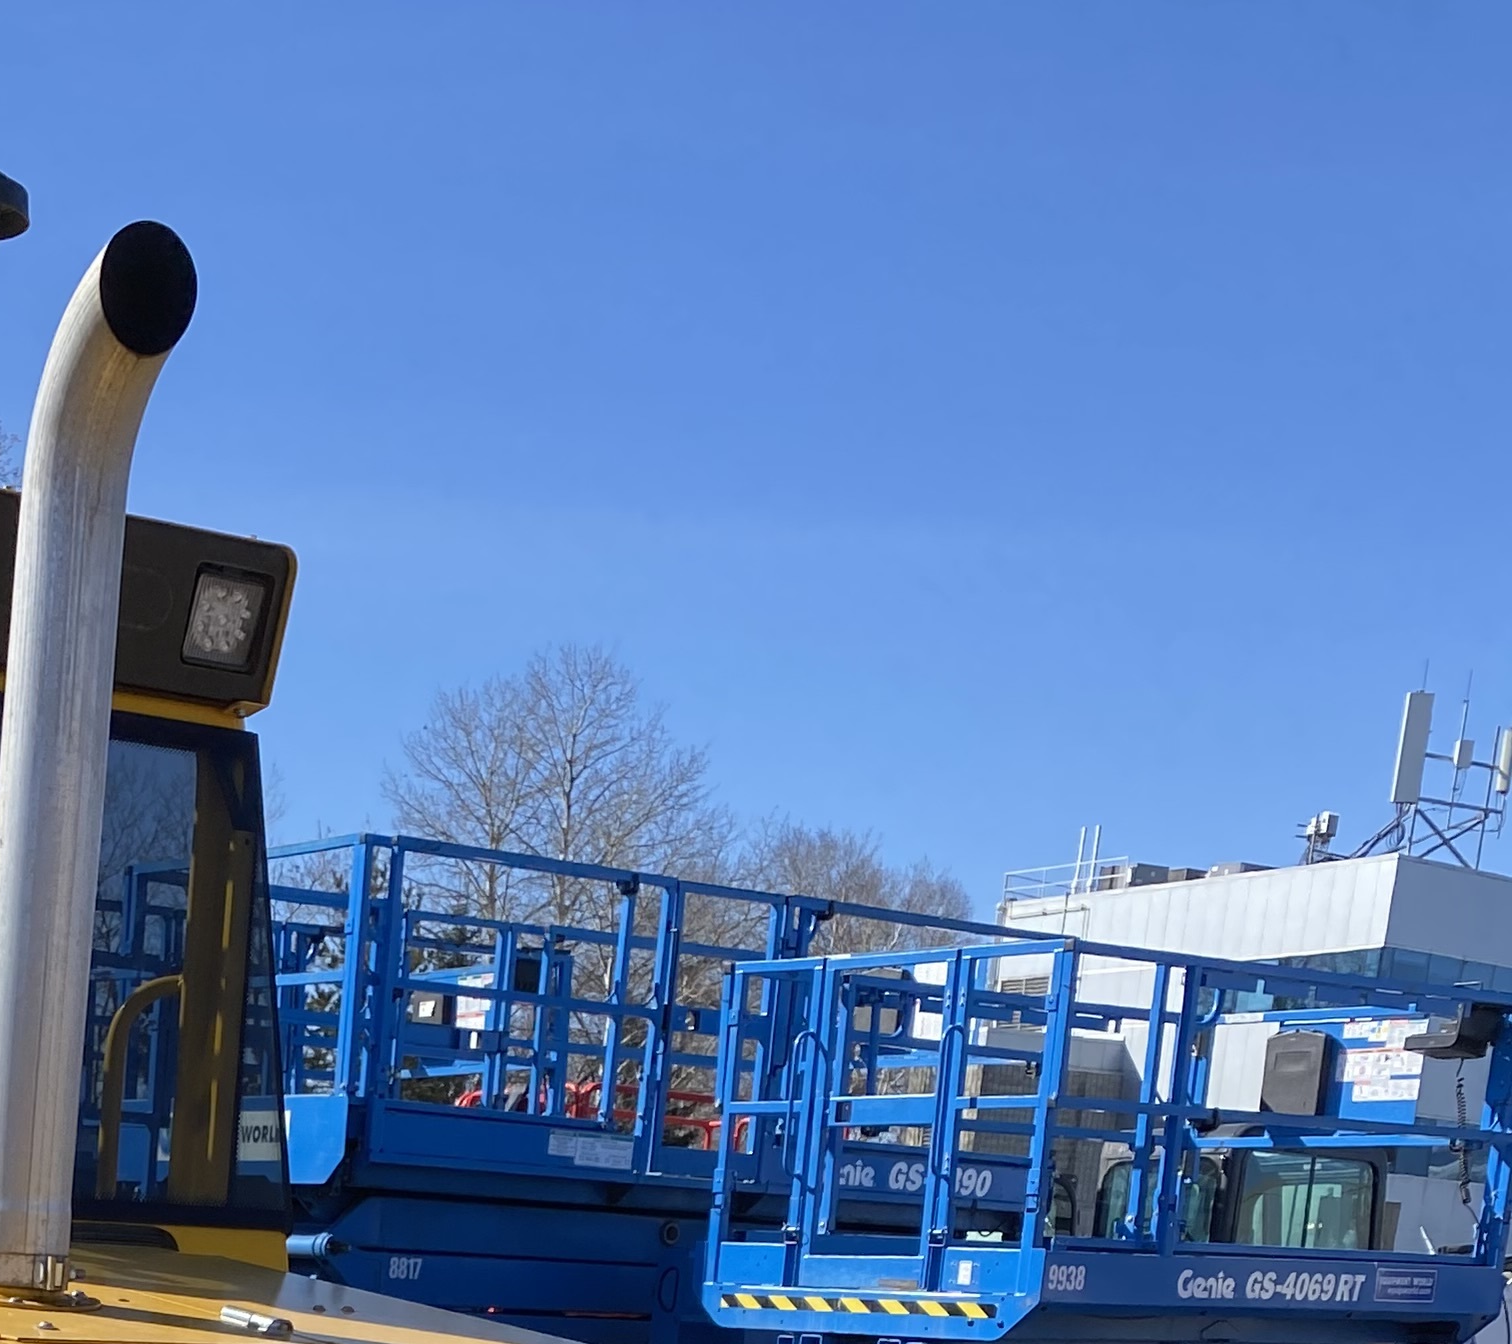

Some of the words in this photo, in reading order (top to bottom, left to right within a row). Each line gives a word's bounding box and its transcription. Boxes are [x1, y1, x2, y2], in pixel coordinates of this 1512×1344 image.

[839, 1159, 876, 1188] nie
[389, 1256, 423, 1280] 8817
[1048, 1264, 1086, 1291] 9938
[1177, 1269, 1236, 1299] Genie
